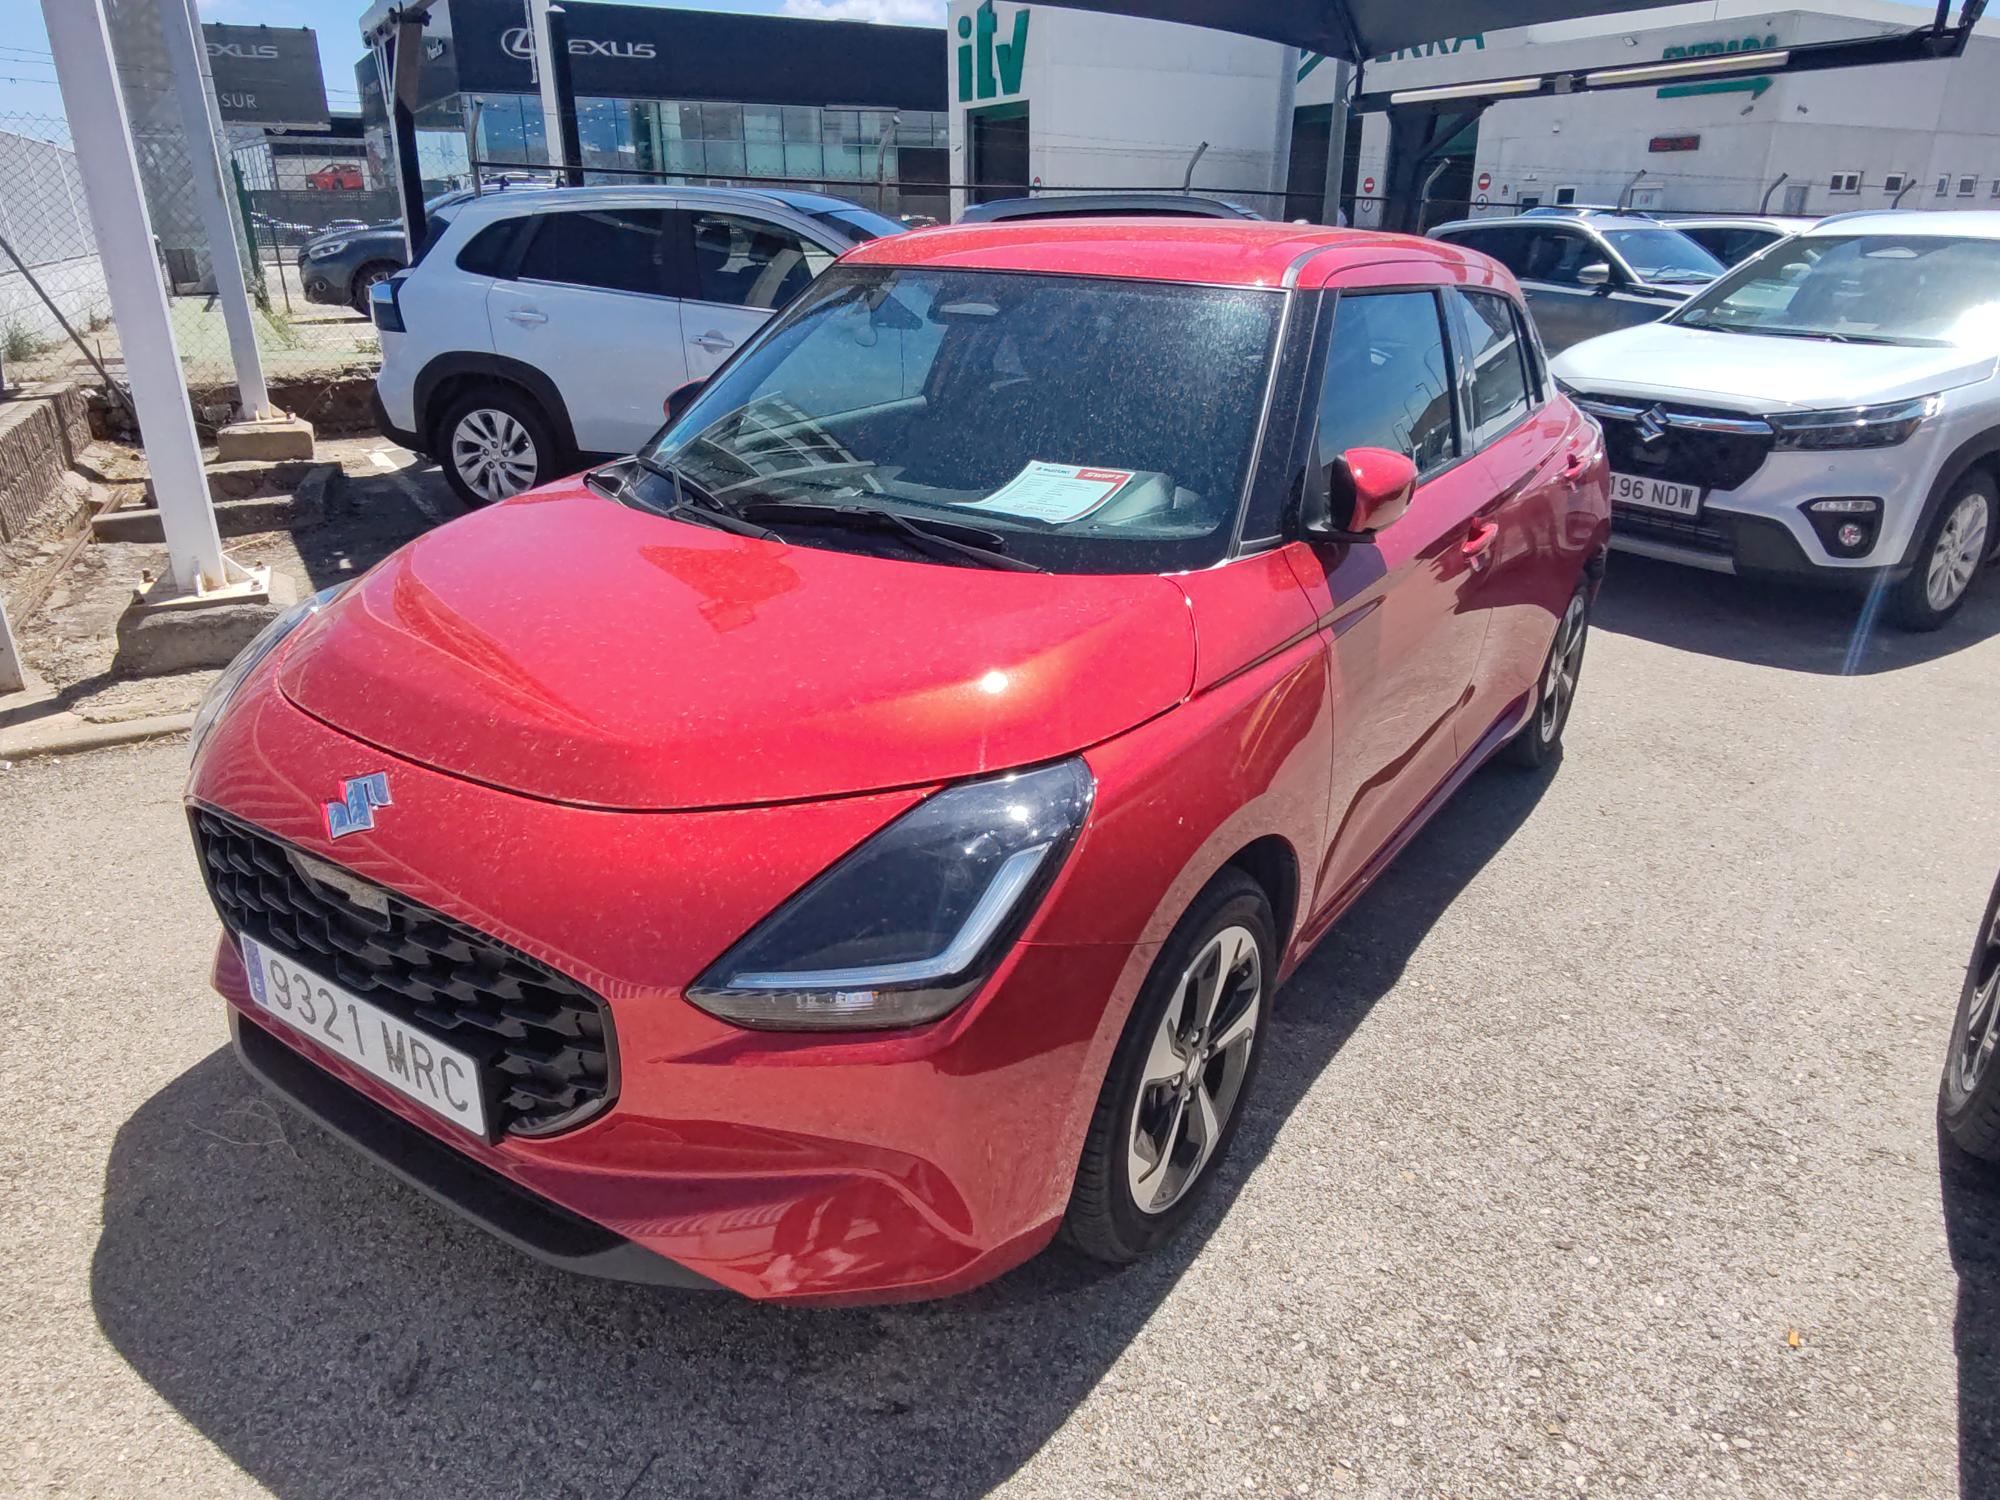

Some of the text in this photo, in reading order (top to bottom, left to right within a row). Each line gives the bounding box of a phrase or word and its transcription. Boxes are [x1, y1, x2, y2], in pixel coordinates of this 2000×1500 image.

[206, 43, 278, 59] EXUS
[568, 39, 657, 59] EXUS
[221, 93, 257, 109] SUR
[1084, 471, 1125, 480] SWIFT
[1610, 476, 1693, 509] 196 NDW
[269, 959, 469, 1112] 9321 MRC
